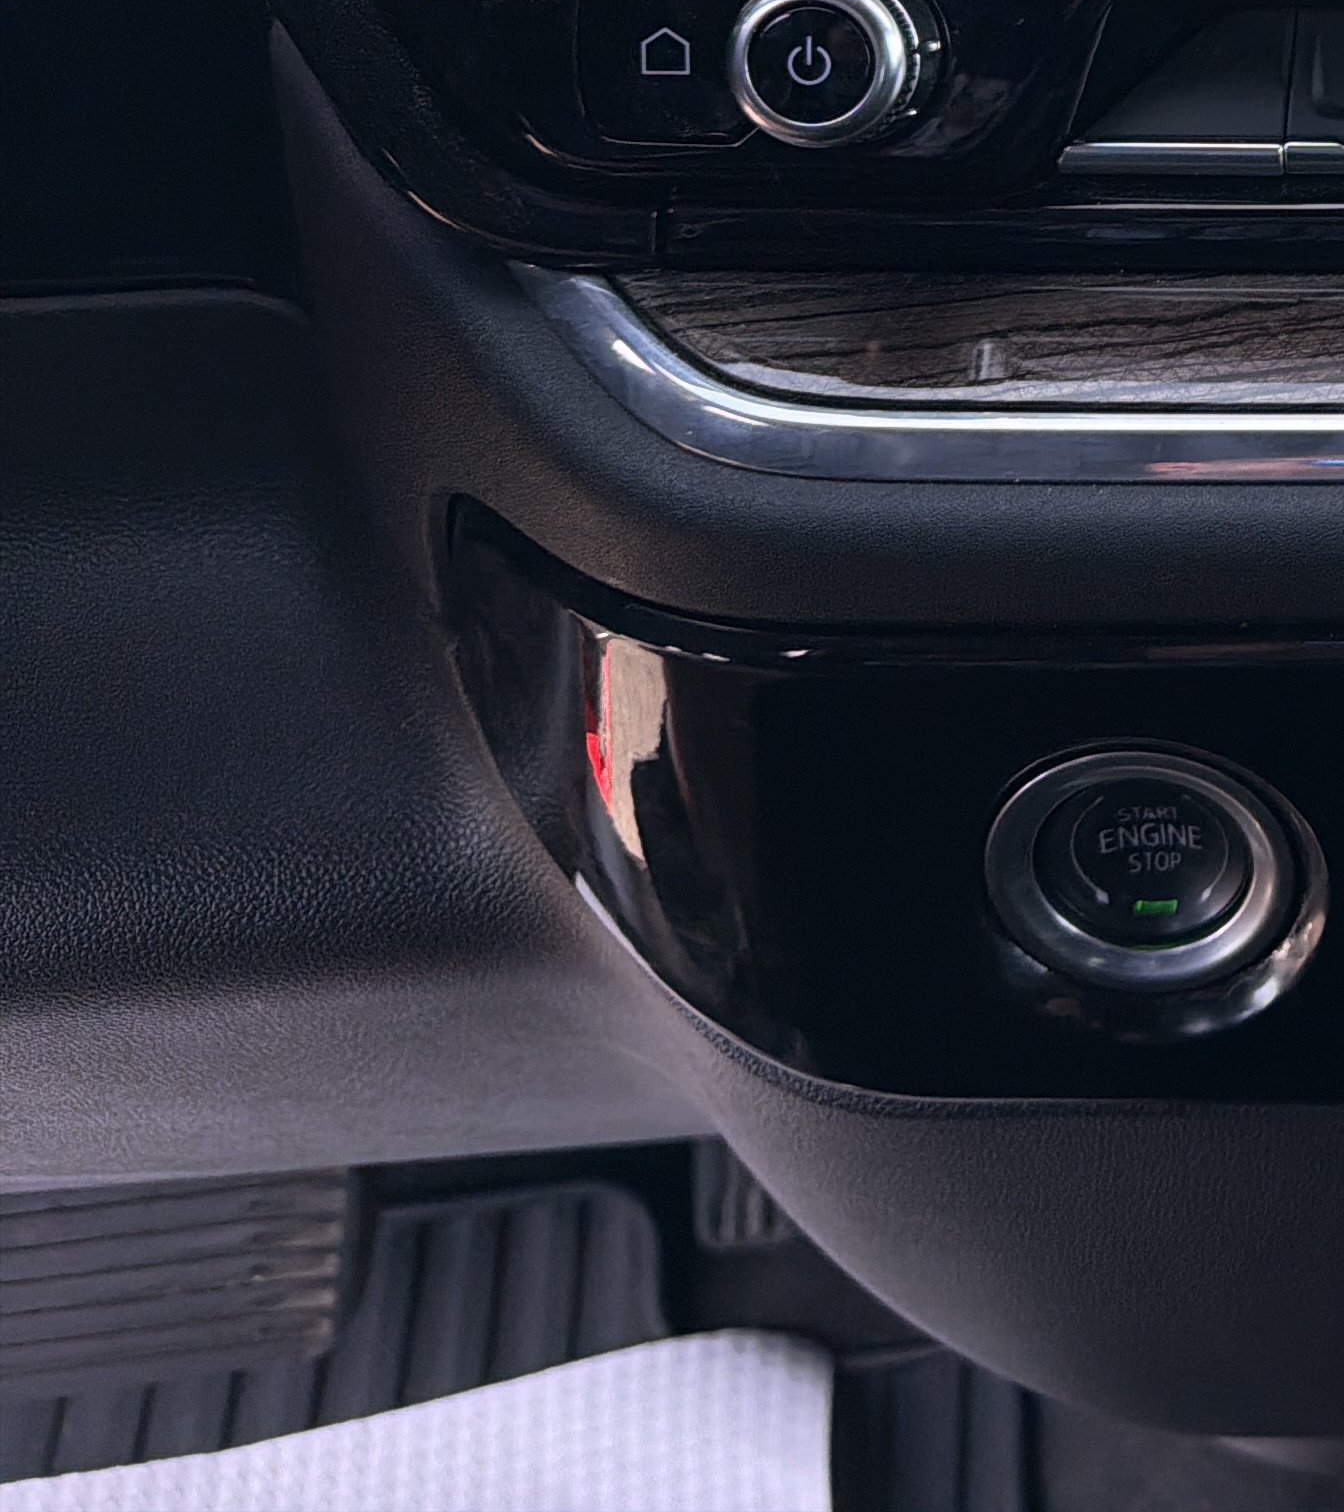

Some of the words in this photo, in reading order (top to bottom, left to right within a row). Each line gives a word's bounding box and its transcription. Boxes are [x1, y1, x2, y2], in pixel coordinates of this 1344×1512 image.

[1117, 806, 1177, 822] START
[1098, 822, 1203, 854] ENGINE
[1128, 850, 1181, 873] STOP
